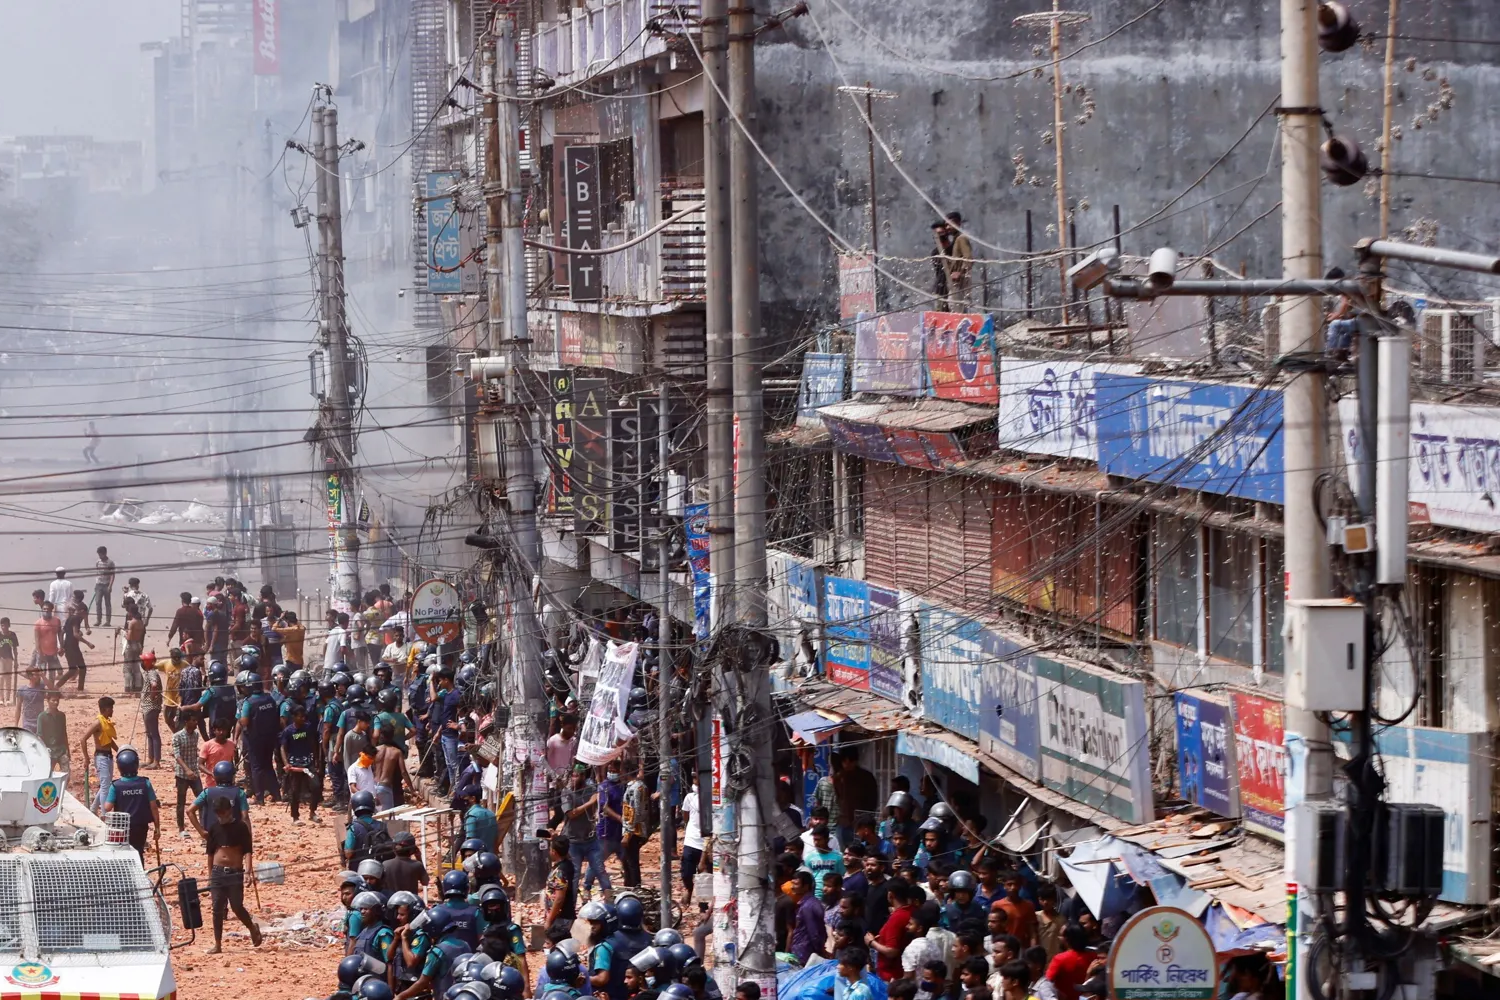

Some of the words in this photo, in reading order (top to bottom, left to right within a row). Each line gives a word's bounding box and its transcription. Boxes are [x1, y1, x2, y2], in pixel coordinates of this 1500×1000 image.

[415, 608, 427, 616] No
[1121, 964, 1160, 984] পার্কিং
[1166, 964, 1208, 983] নিষেধ
